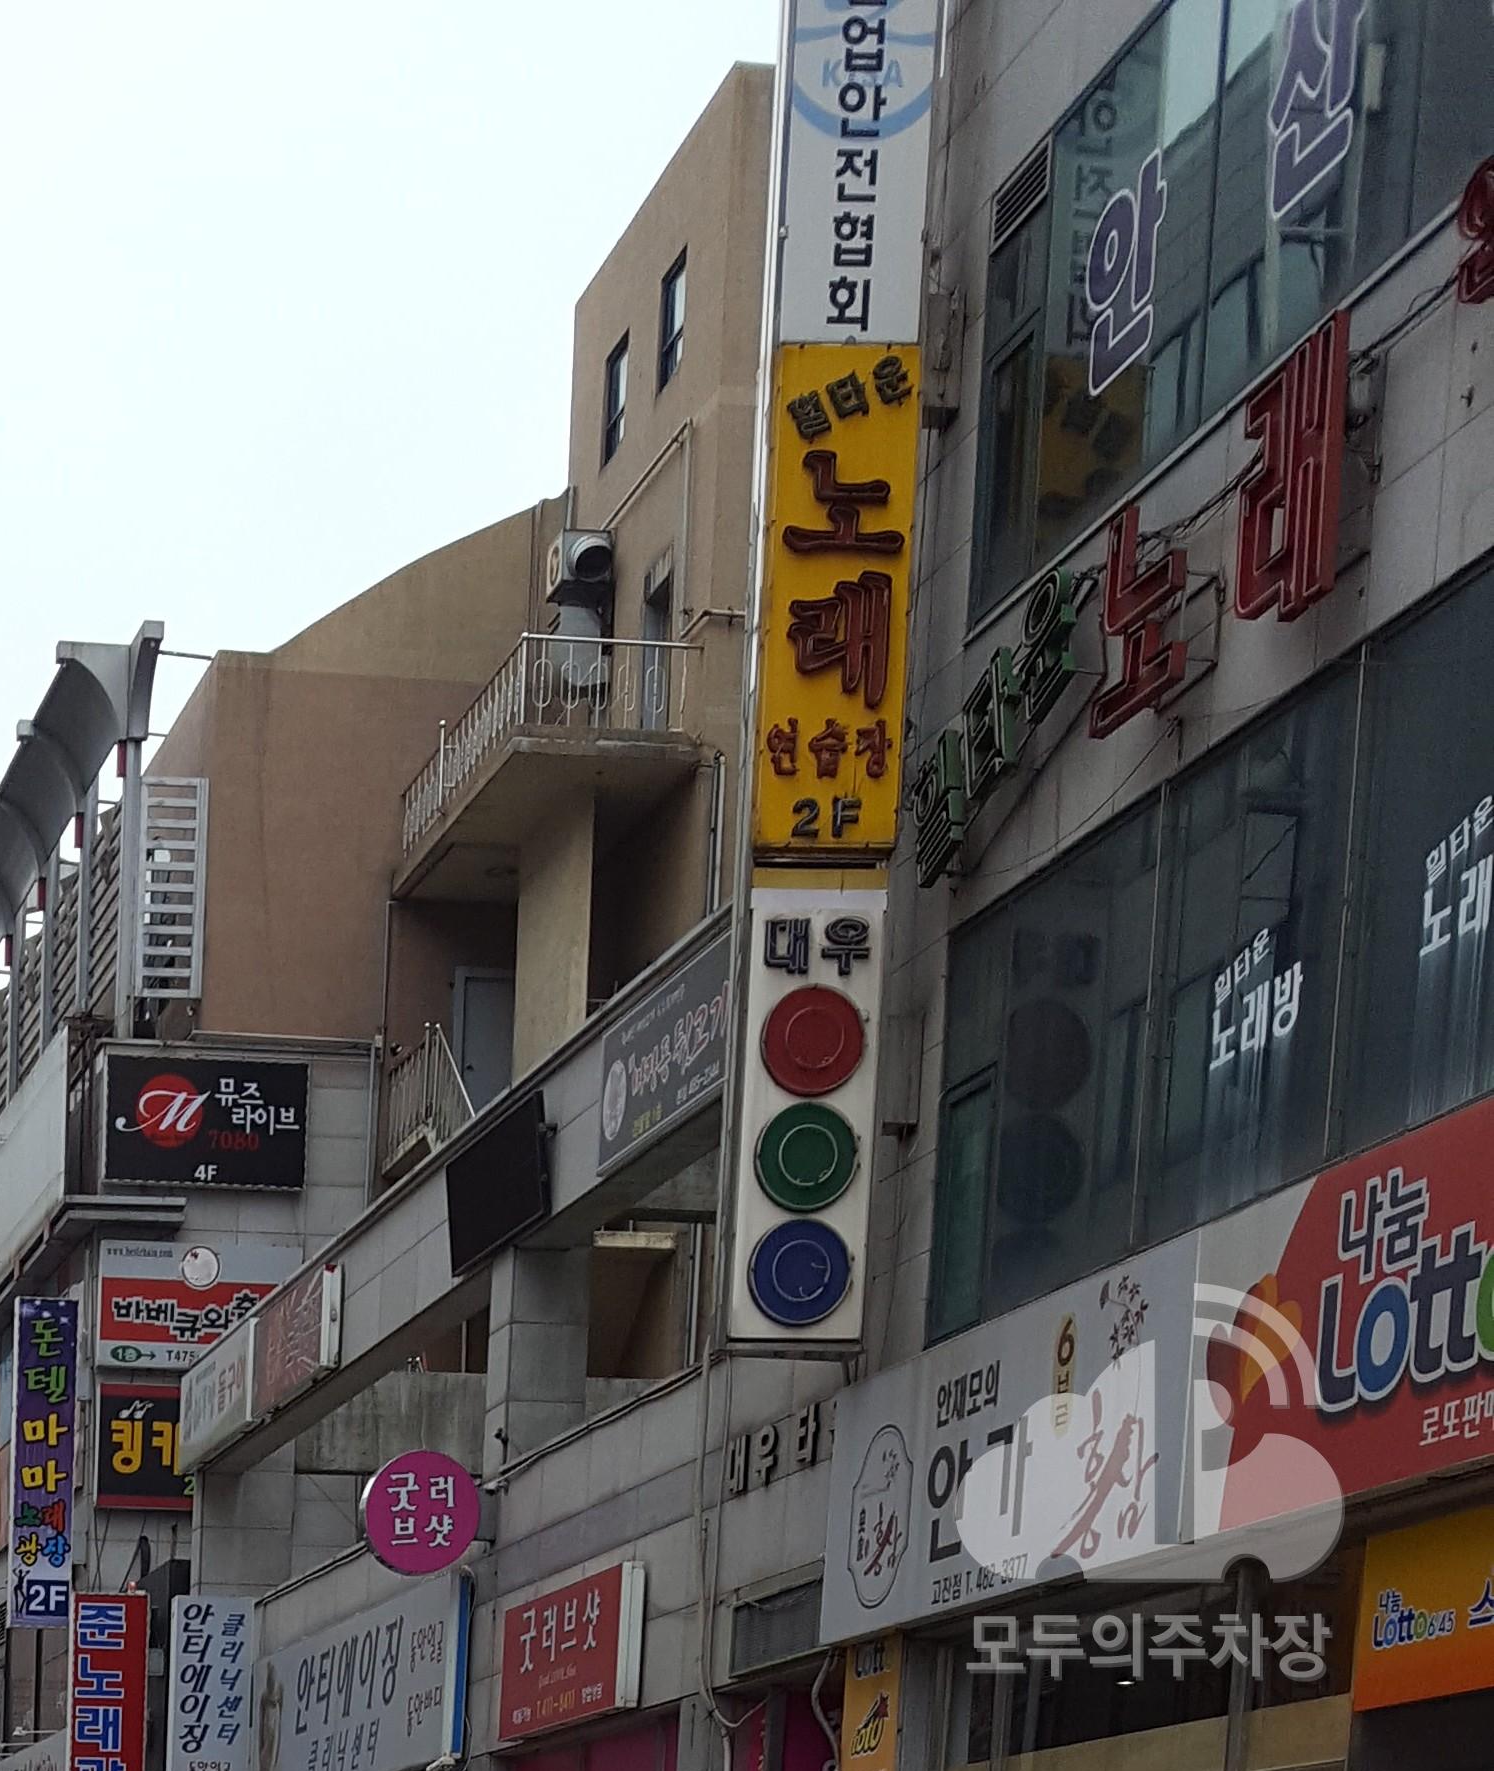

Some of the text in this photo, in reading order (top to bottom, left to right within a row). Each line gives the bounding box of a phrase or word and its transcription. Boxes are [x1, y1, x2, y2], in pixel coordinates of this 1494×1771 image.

[827, 0, 887, 331] 업안전협회
[783, 450, 905, 709] 노래
[766, 716, 893, 779] 연습장
[792, 796, 862, 839] 2F
[764, 917, 871, 977] 대우
[1209, 961, 1304, 1071] 노래방
[214, 1077, 265, 1107] 뮤즈
[230, 1105, 301, 1136] 라이브
[193, 1163, 218, 1182] 4F
[208, 1128, 260, 1152] 7080
[1337, 1166, 1429, 1286] 나눔
[936, 1358, 1000, 1429] 안재모의
[28, 1581, 70, 1612] 2F
[1373, 1607, 1428, 1649] Lotto
[520, 1585, 601, 1676] 굿러브샷
[179, 1602, 215, 1755] 안티에이징
[217, 1611, 246, 1746] 클리닉센터
[295, 1614, 405, 1737] 안티에이징
